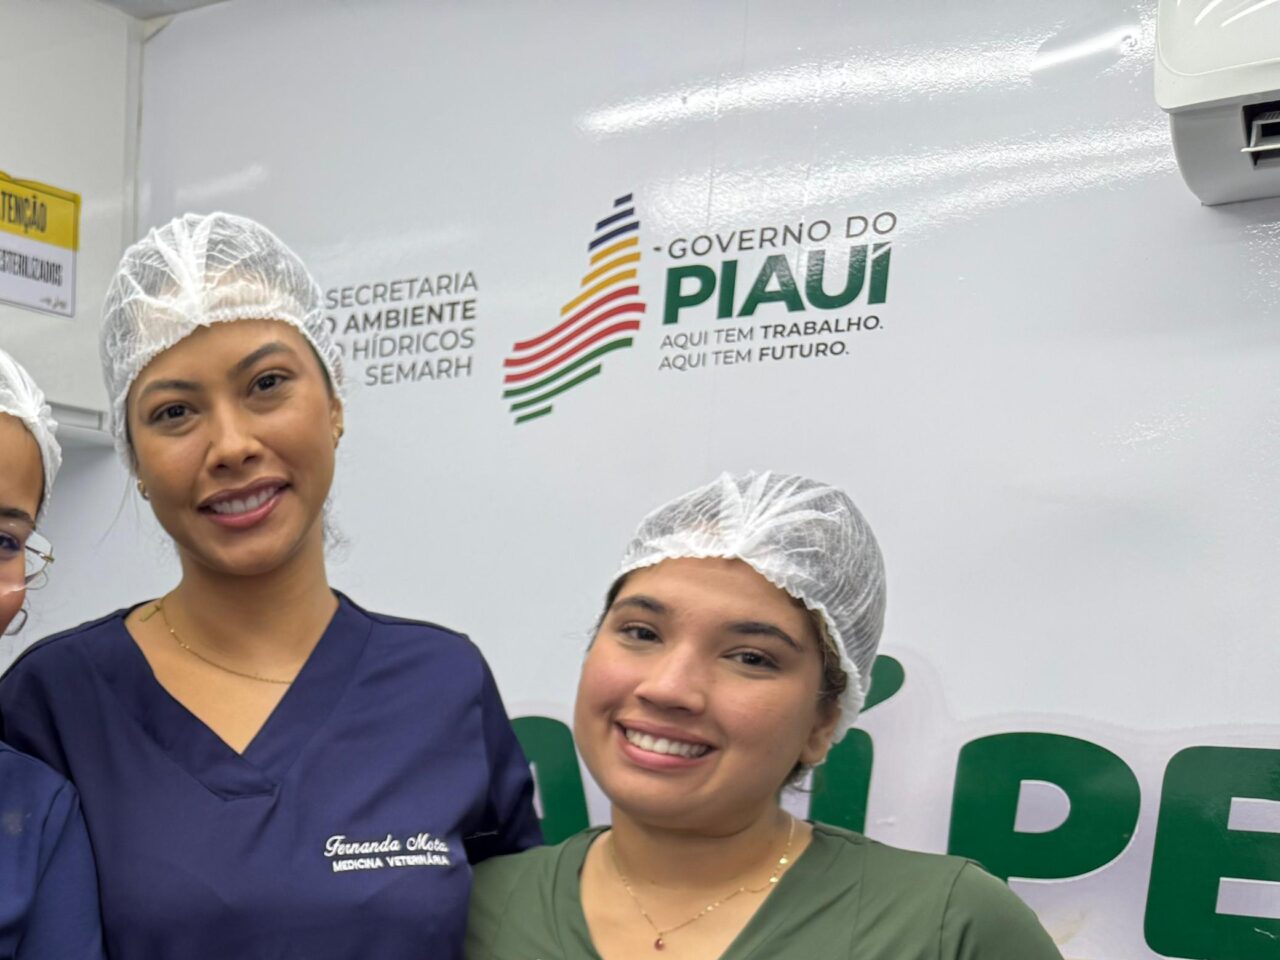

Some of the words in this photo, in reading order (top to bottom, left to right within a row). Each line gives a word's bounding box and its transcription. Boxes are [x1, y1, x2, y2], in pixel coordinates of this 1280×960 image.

[668, 219, 831, 259] GOVERNO
[845, 211, 897, 239] DO
[325, 271, 478, 310] SECRETARIA
[662, 241, 892, 325] PIAUÍ
[343, 299, 477, 335] AMBIENTE
[660, 330, 709, 350] AQUI
[713, 325, 754, 344] TEM
[760, 315, 884, 340] TRABALHO.
[352, 327, 475, 361] HÍDRICOS
[658, 351, 707, 371] AQUI
[711, 348, 751, 366] TEM
[758, 340, 850, 362] FUTURO.
[365, 356, 472, 386] SEMARH
[324, 833, 400, 857] Fernanda
[332, 857, 384, 872] MEDICINA
[386, 852, 450, 867] VETERINÁRIA
